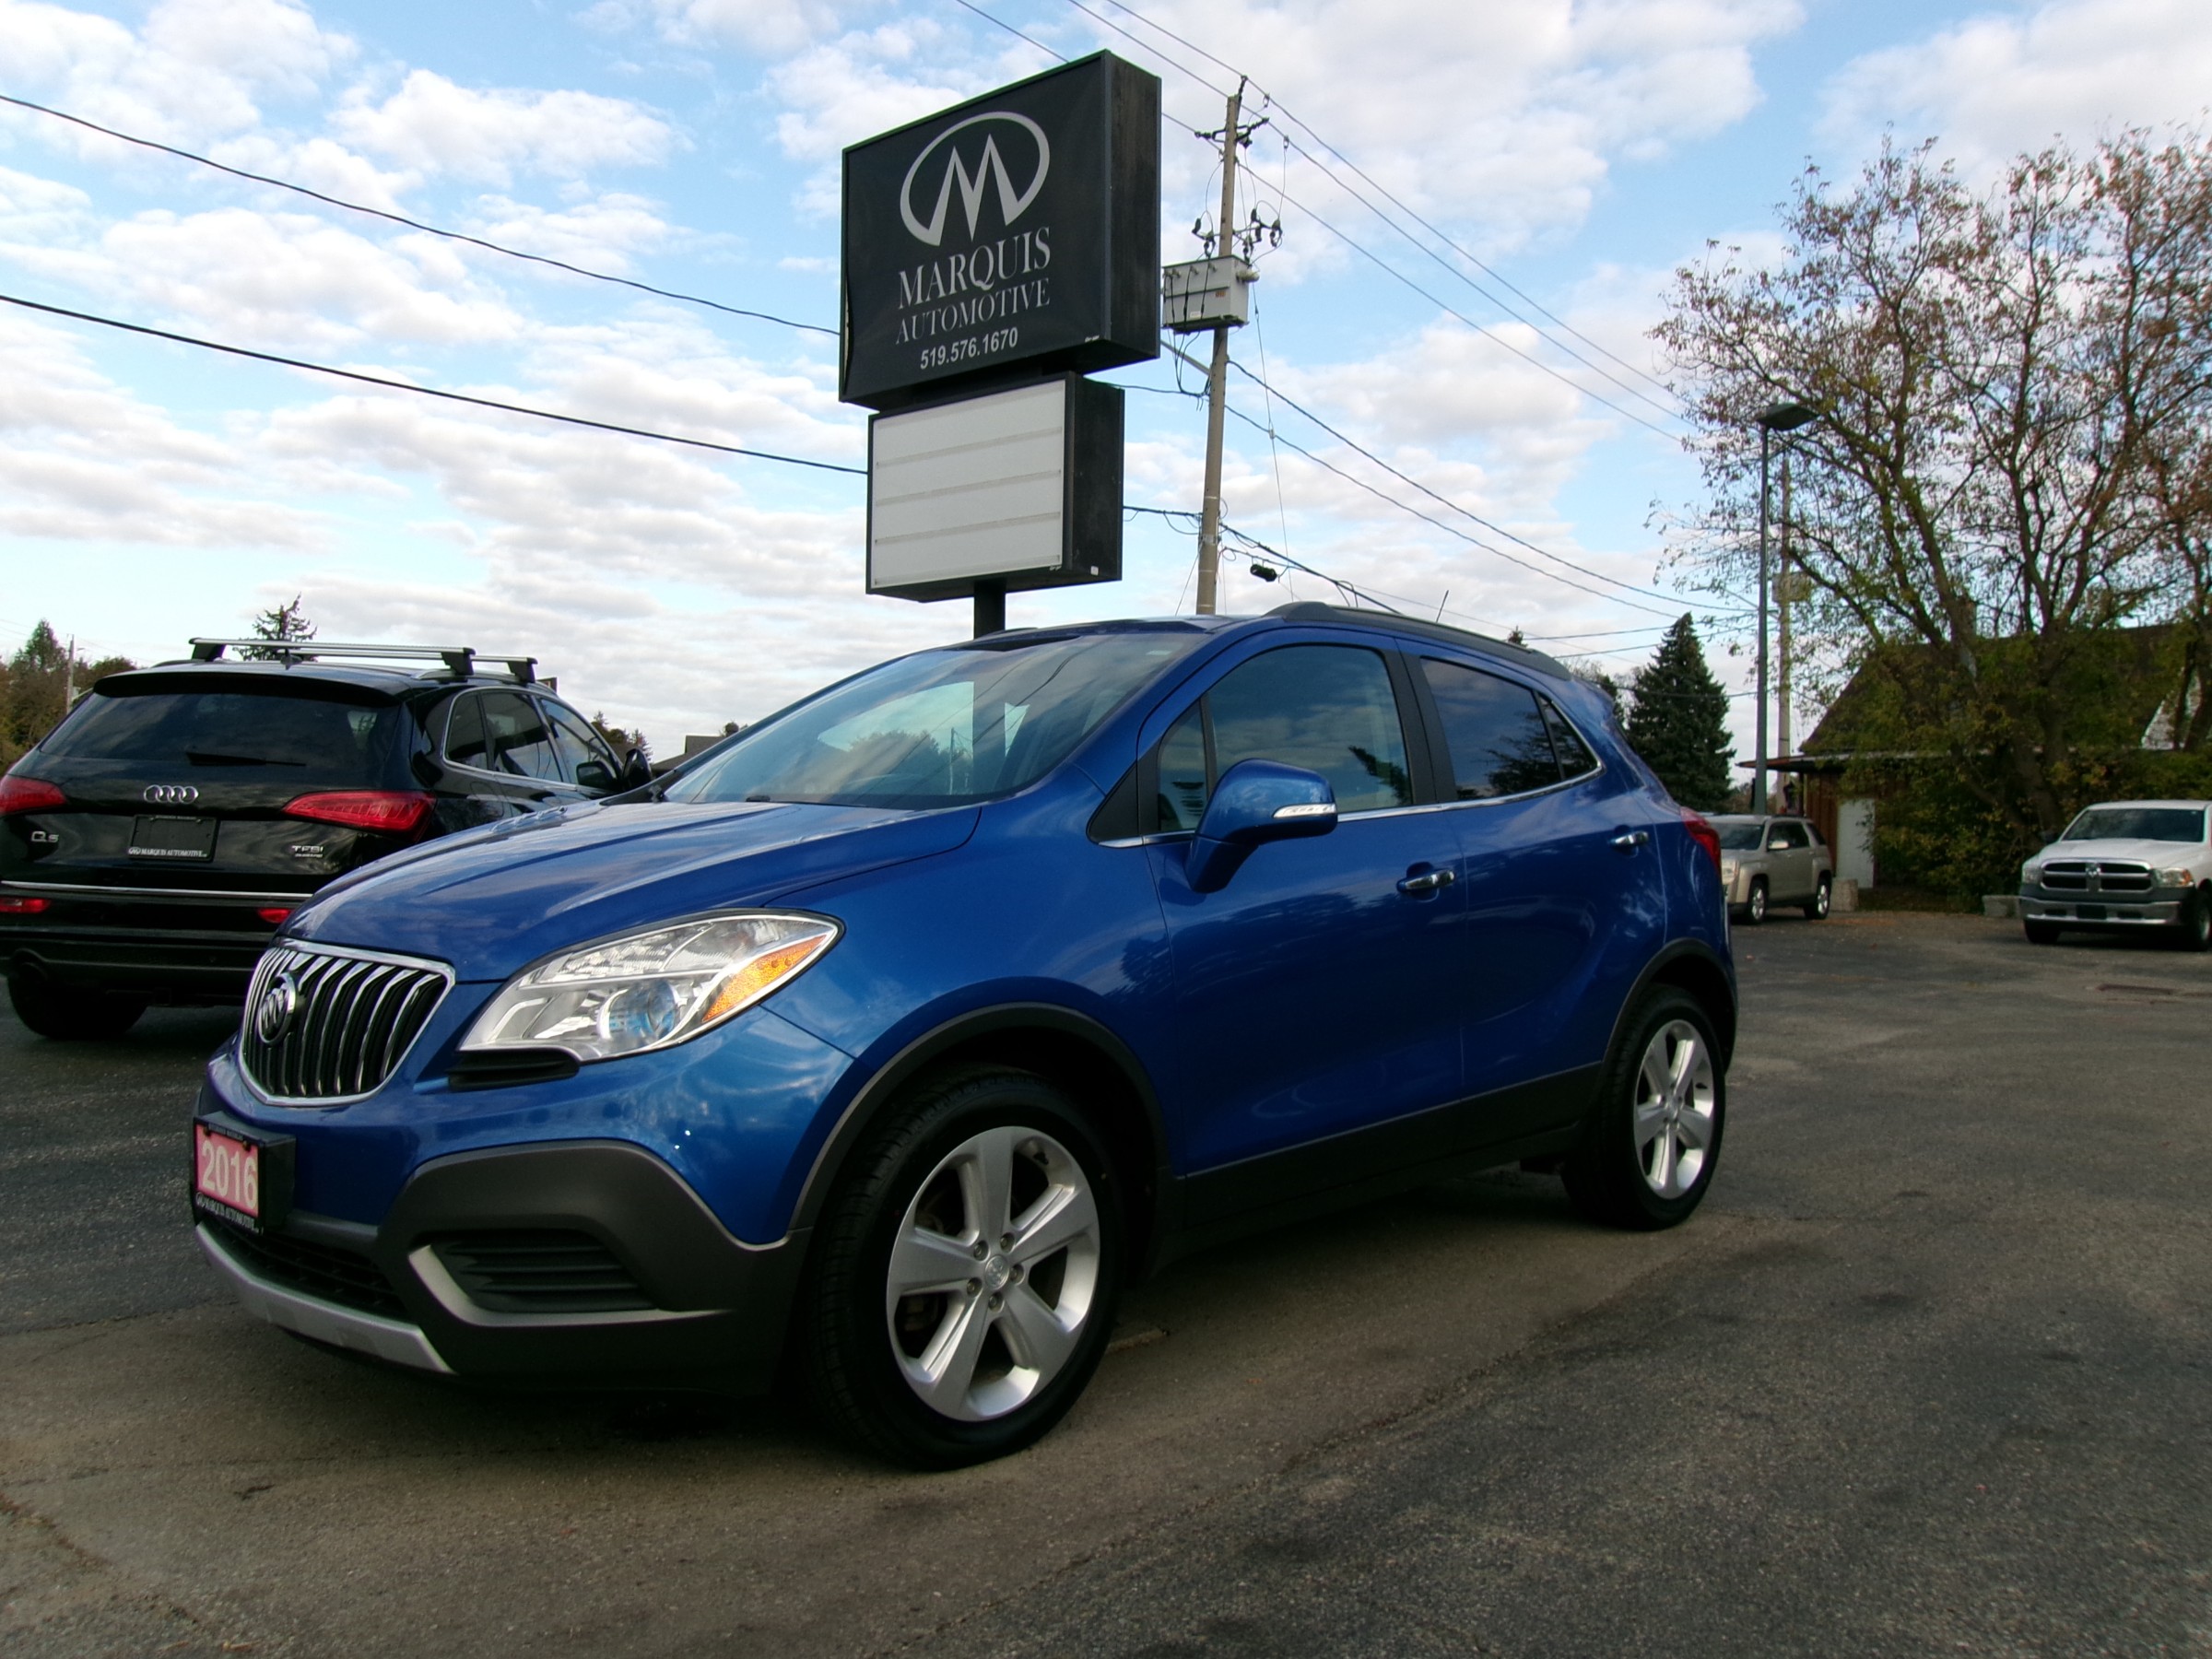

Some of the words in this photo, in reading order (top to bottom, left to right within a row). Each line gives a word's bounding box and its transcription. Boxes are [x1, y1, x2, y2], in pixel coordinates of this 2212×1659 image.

[898, 227, 1051, 310] MARQUIS
[895, 278, 1051, 345] AUTOMOTIVE
[920, 327, 1018, 371] 519.576.1670
[141, 848, 166, 856] MARQUIS
[167, 849, 203, 857] AUTOMOTIVE
[202, 1139, 257, 1210] 2016
